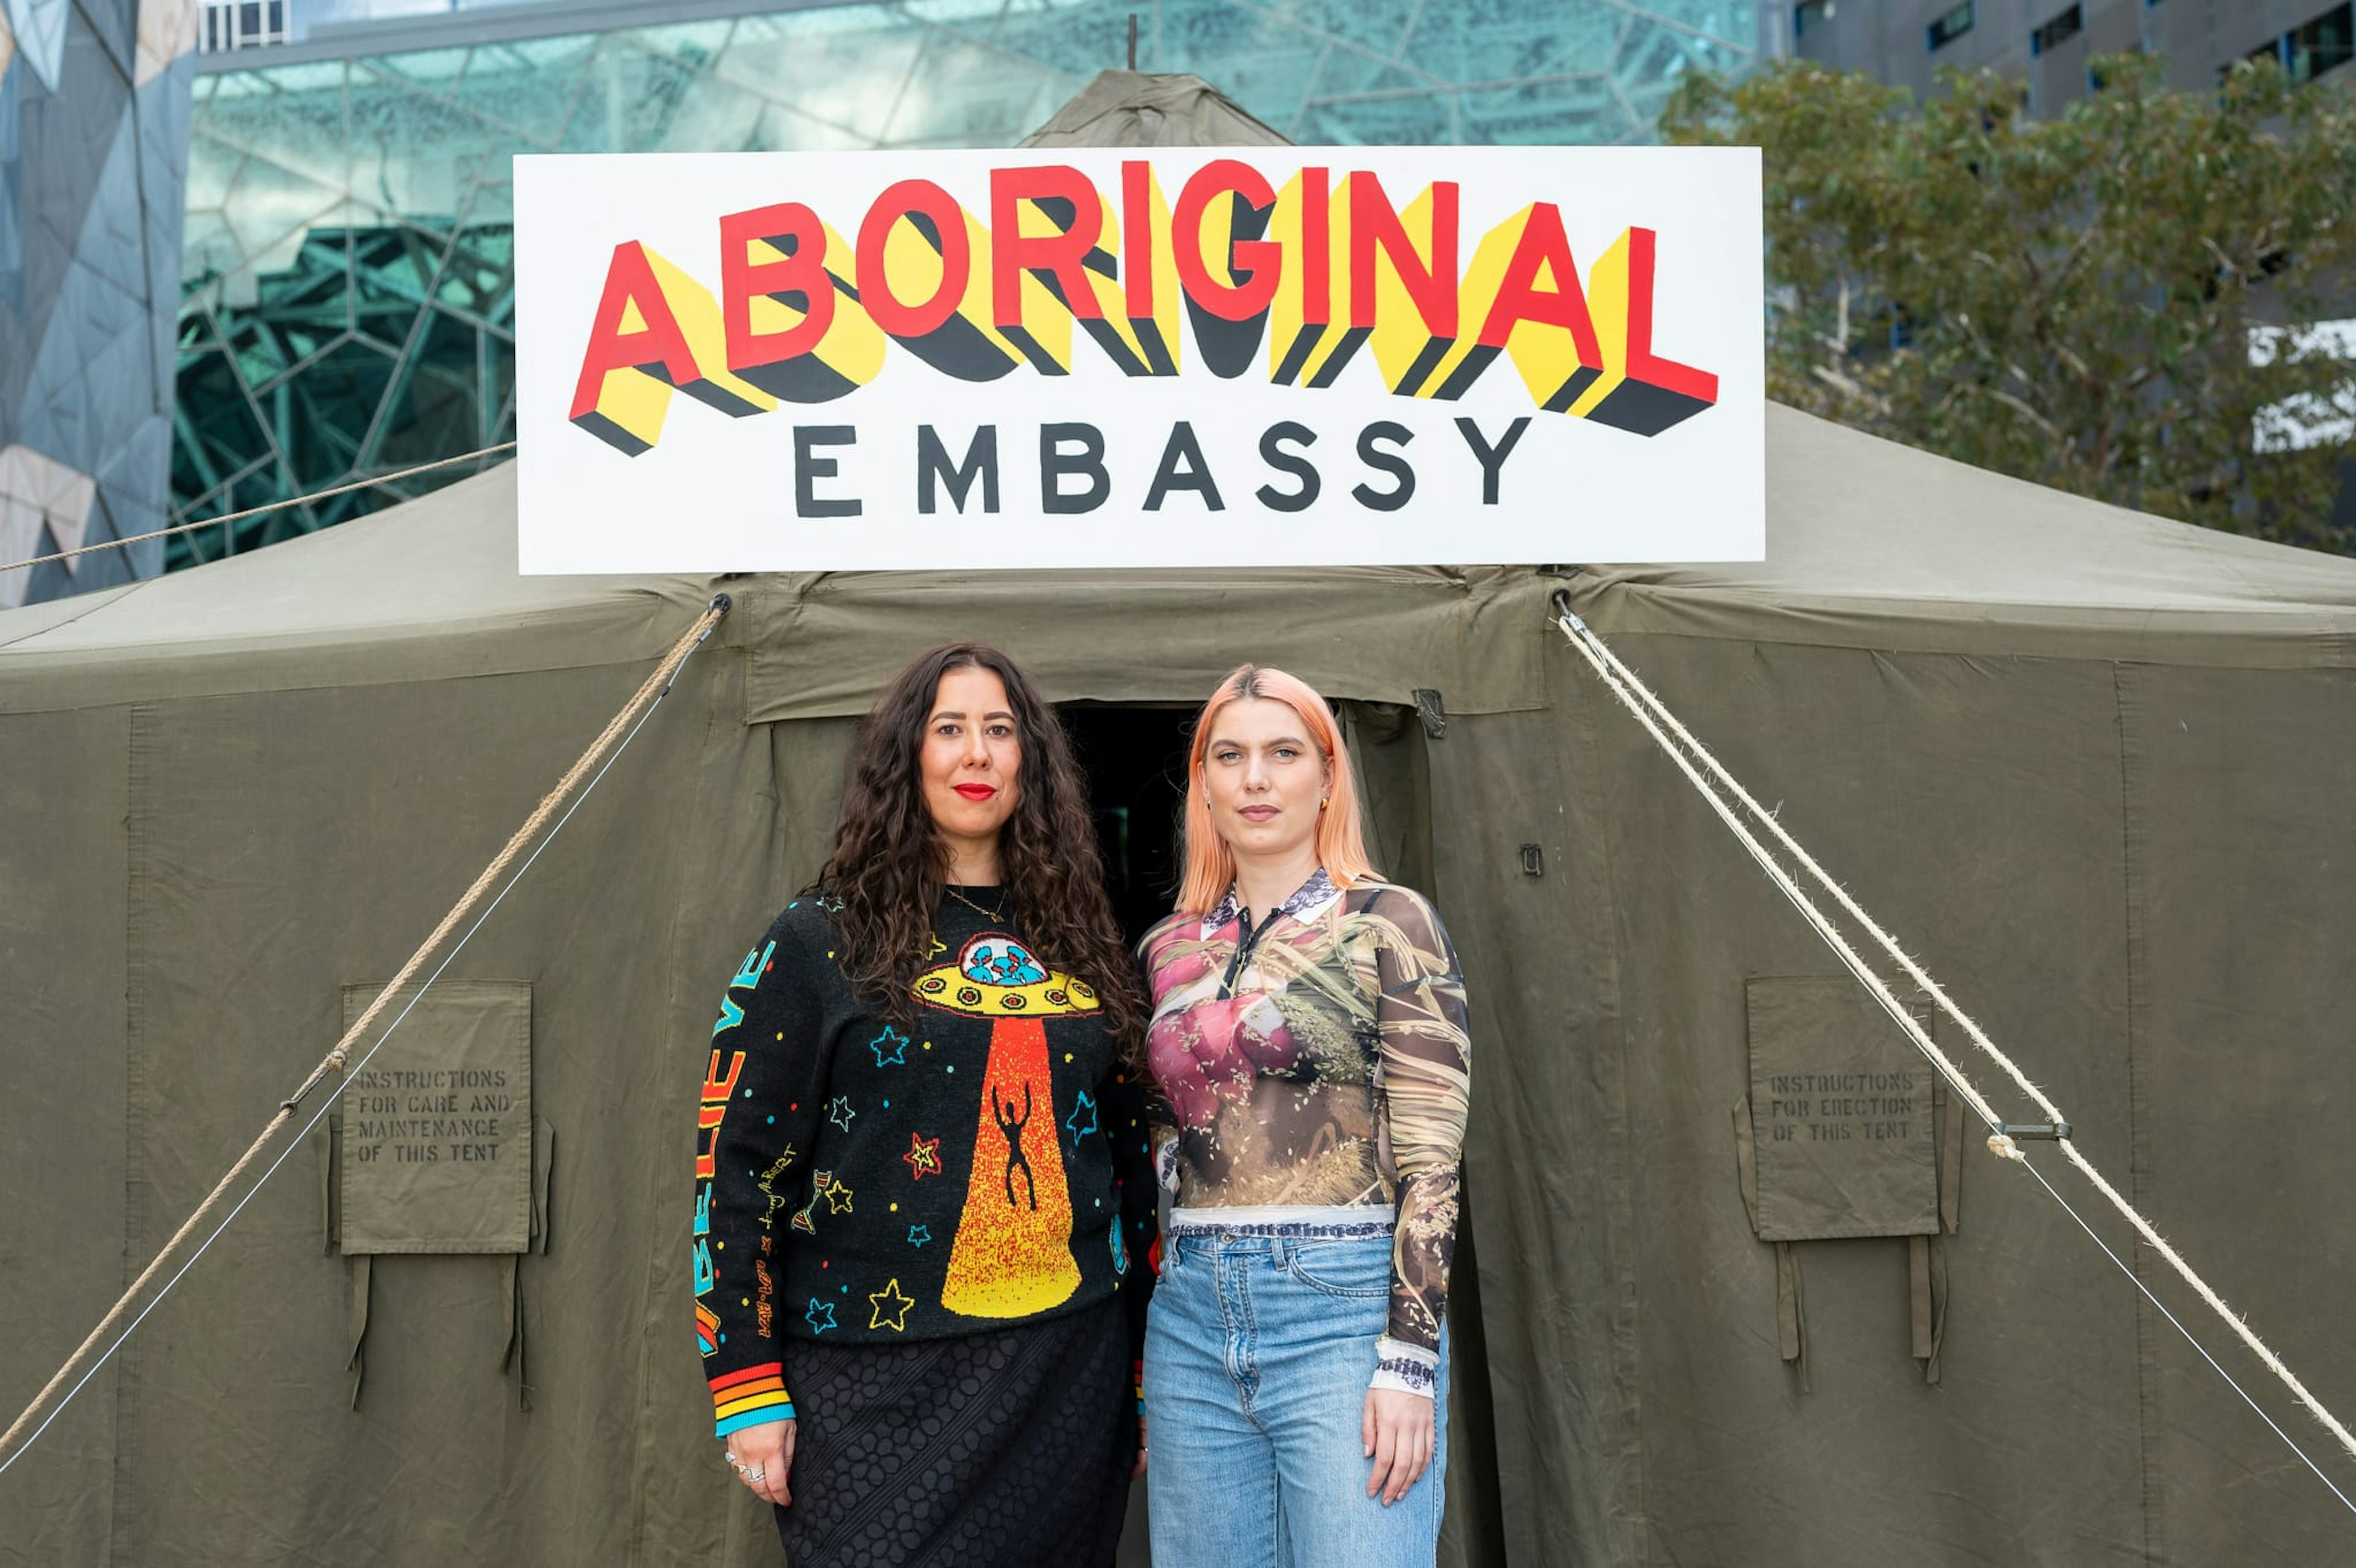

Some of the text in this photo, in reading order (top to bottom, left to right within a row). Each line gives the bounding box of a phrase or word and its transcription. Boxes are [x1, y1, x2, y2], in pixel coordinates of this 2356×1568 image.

[569, 159, 1719, 458] ABORIGINAL
[793, 417, 1533, 517] EMBASSY
[360, 1070, 506, 1089] INSTRUCTIONS
[1771, 1072, 1914, 1093] INSTRUCTIONS
[360, 1094, 509, 1113] FOR CARE AND
[1771, 1097, 1912, 1117] FOR ERECTION
[359, 1119, 499, 1138] MAINTENANCE
[693, 940, 776, 1297] BELIEVE
[1773, 1121, 1910, 1142] OF THIS TENT
[358, 1143, 499, 1163] OF THIS TENT
